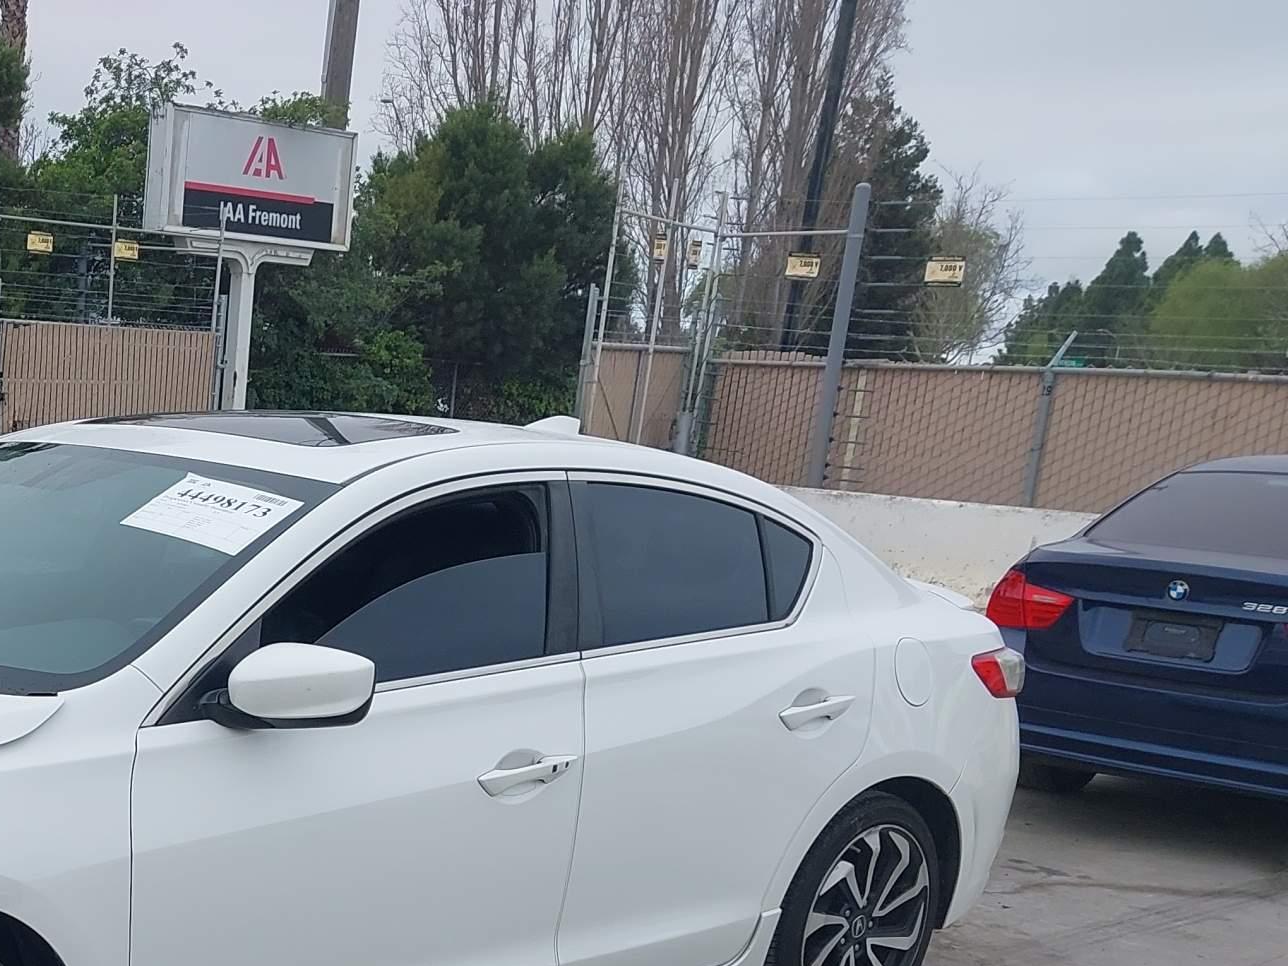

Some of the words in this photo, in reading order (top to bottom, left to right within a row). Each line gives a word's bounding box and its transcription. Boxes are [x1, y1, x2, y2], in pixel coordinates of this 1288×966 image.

[219, 201, 245, 223] IAA
[248, 204, 301, 230] Fremont
[177, 488, 272, 518] 44498173
[1242, 602, 1288, 614] 328
